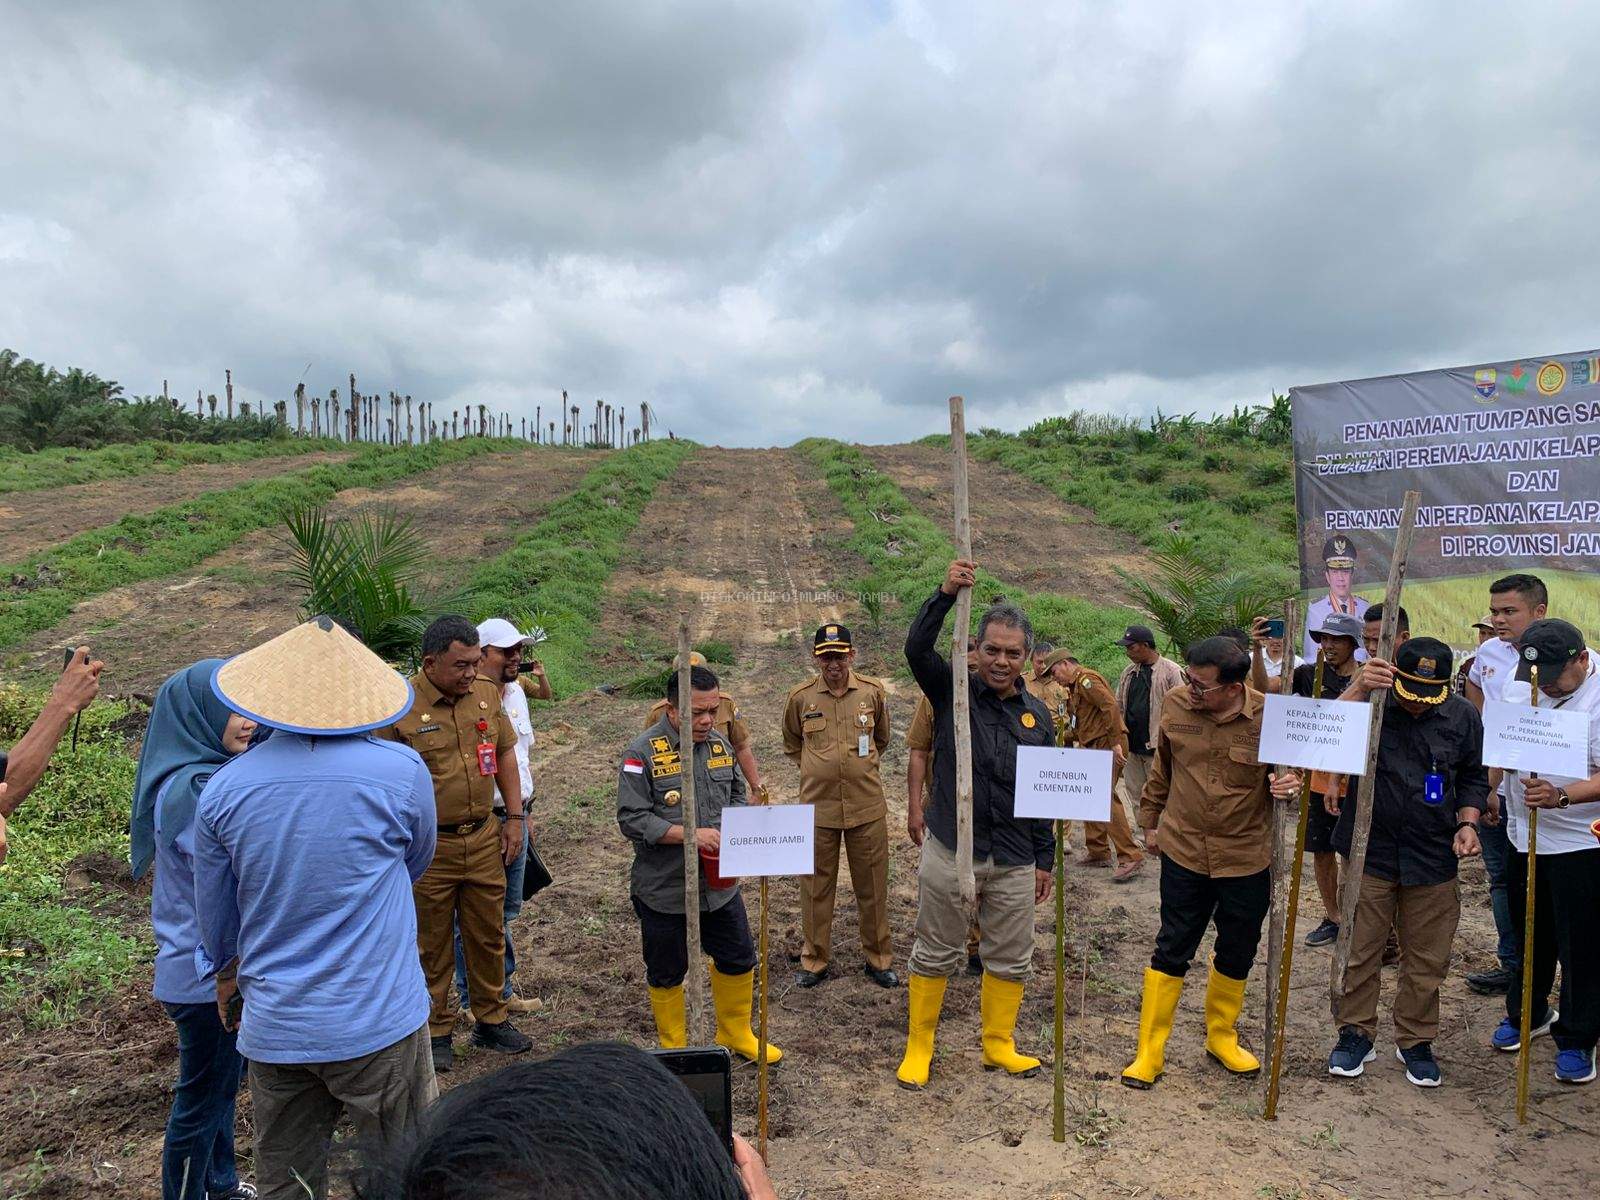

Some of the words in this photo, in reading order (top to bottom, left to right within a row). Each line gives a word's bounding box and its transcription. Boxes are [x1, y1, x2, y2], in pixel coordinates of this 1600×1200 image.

[1343, 416, 1459, 443] PENANAMAN
[1463, 404, 1572, 432] TUMPANG
[1395, 439, 1530, 469] PEREMAJAAN
[1531, 434, 1600, 460] KELAP
[1507, 470, 1559, 492] DAN
[1325, 506, 1430, 529] PENANAMN
[1432, 503, 1527, 527] PERDANA
[1528, 501, 1600, 523] KELAP
[1441, 536, 1462, 556] DI
[1463, 534, 1559, 556] PROVINSI
[1286, 708, 1317, 721] KEPALA
[1318, 711, 1346, 723] DINAS
[1519, 716, 1553, 728] DIREKTUR
[1286, 720, 1343, 734] PERKEBUNAN
[1506, 725, 1516, 733] PT.
[1518, 726, 1564, 740] PERKEBUNAN
[1286, 733, 1310, 744] PROV.
[1313, 736, 1341, 747] JAMBI
[1498, 732, 1540, 746] NUSANTARA
[1541, 738, 1548, 746] IV
[1549, 739, 1571, 750] JAMBI
[1038, 770, 1088, 782] DIRJENBUN
[1032, 783, 1082, 795] KEMENTAN
[1083, 785, 1093, 795] RI
[729, 835, 776, 847] GUBERNUR
[777, 835, 806, 846] JAMBI
